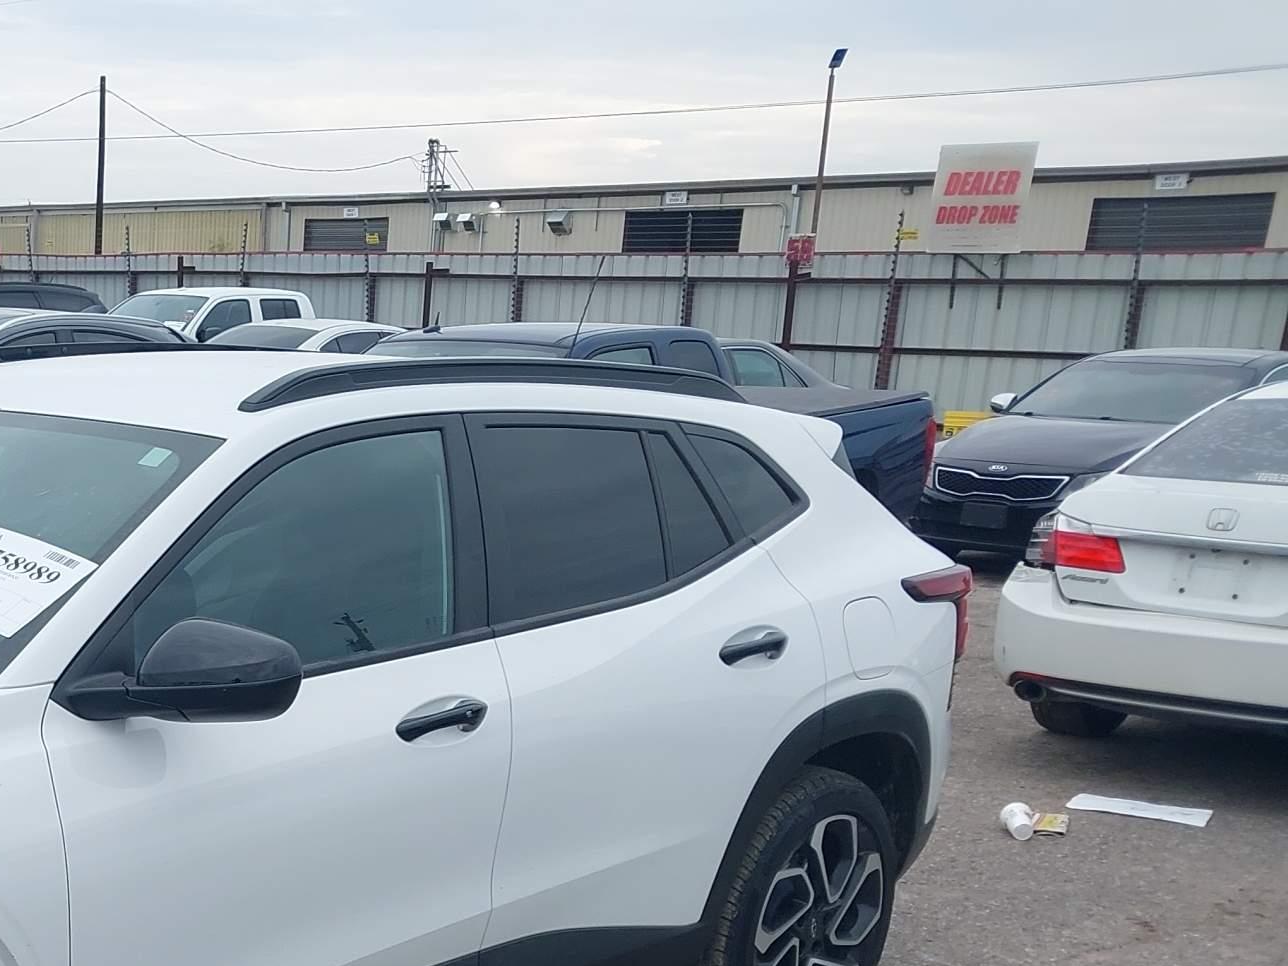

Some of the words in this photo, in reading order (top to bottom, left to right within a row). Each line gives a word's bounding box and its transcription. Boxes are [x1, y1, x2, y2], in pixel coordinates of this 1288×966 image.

[943, 171, 1021, 196] DEALER
[935, 206, 978, 224] DROP
[979, 205, 1020, 224] ZONE
